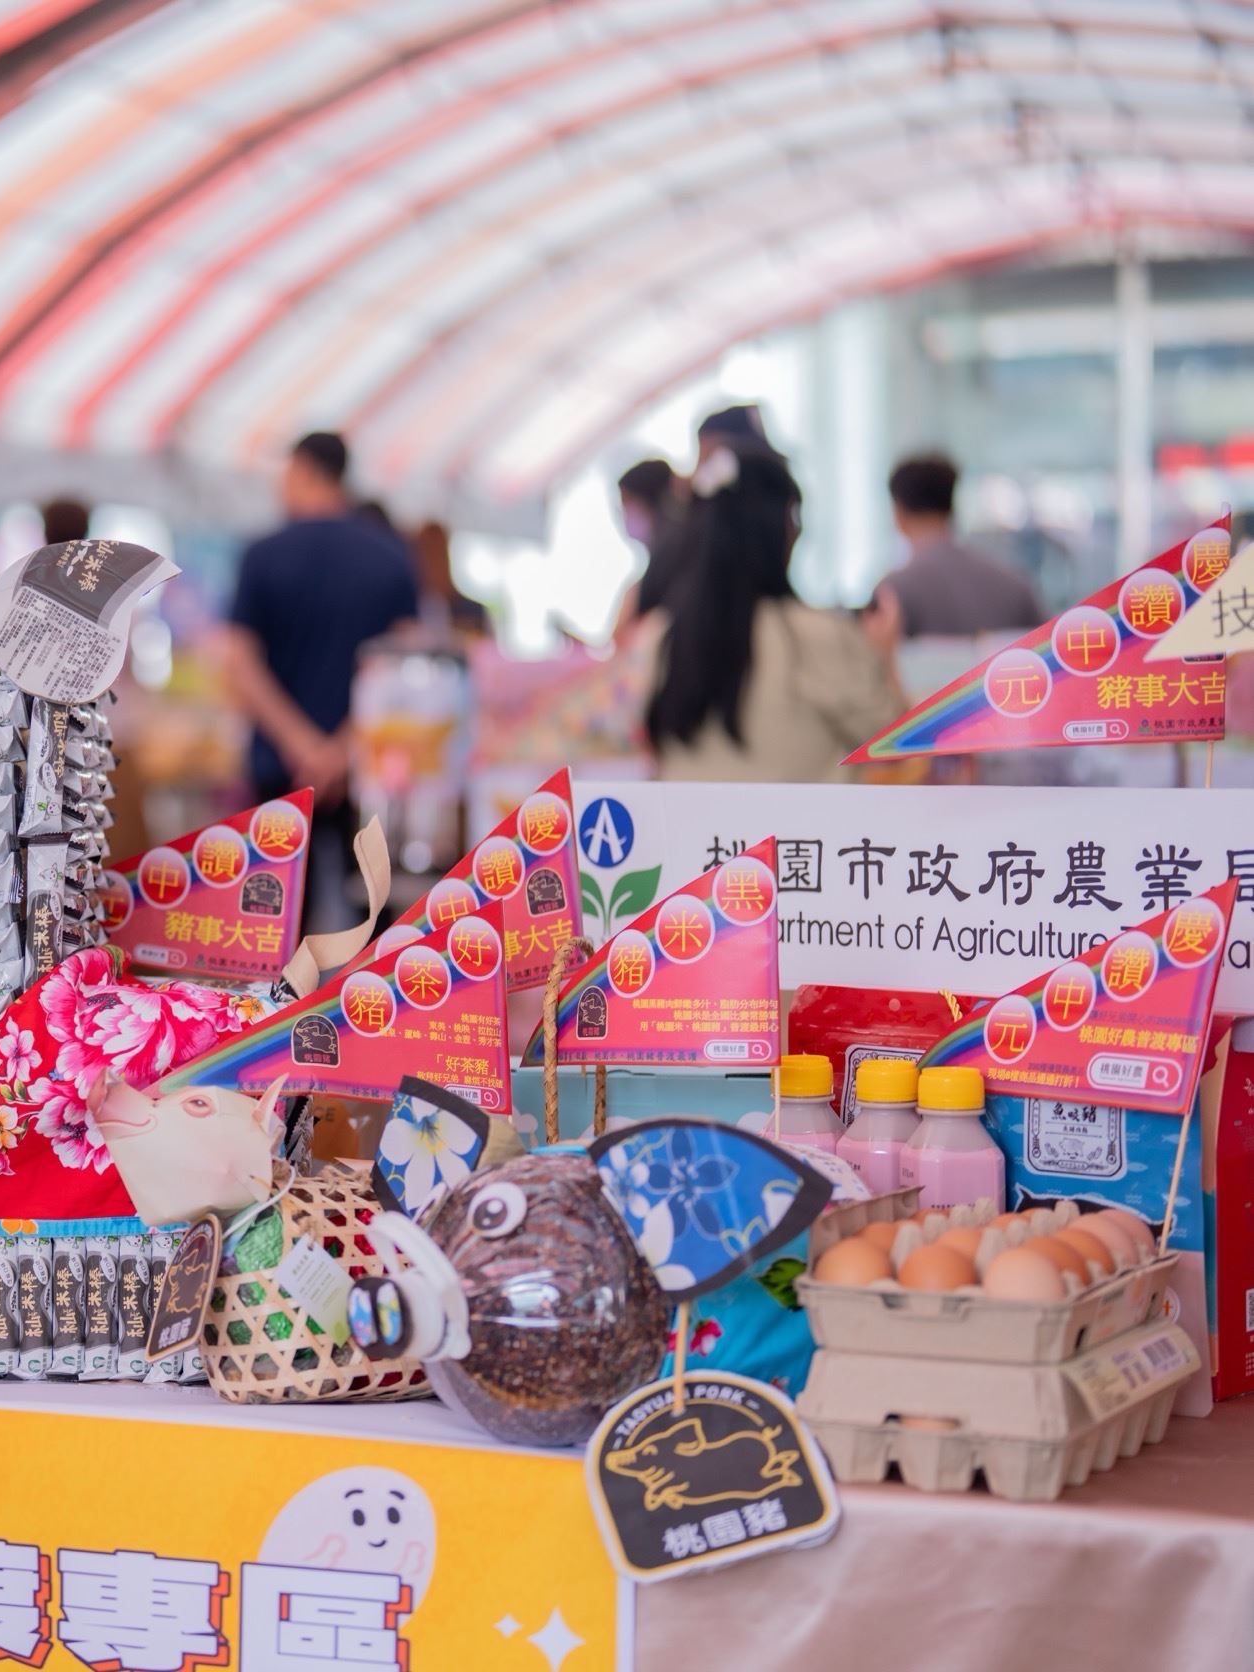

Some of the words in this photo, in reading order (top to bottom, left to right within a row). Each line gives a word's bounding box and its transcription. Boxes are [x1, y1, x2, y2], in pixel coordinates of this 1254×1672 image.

[1213, 587, 1254, 639] 技
[1097, 671, 1226, 709] 豬事大吉
[165, 910, 285, 954] 豬事大吉
[613, 867, 765, 988] 黑米豬
[895, 916, 924, 952] of
[933, 916, 1108, 962] Agriculture
[349, 928, 495, 1028] 好茶豬
[991, 910, 1213, 1054] 慶讚中元
[21, 1271, 44, 1337] 秈米棒
[56, 1267, 79, 1334] 秈米棒
[88, 1267, 110, 1334] 秈米棒
[123, 1272, 146, 1338] 秈米棒
[693, 1384, 745, 1405] PORK
[662, 1498, 788, 1559] 桃園豬
